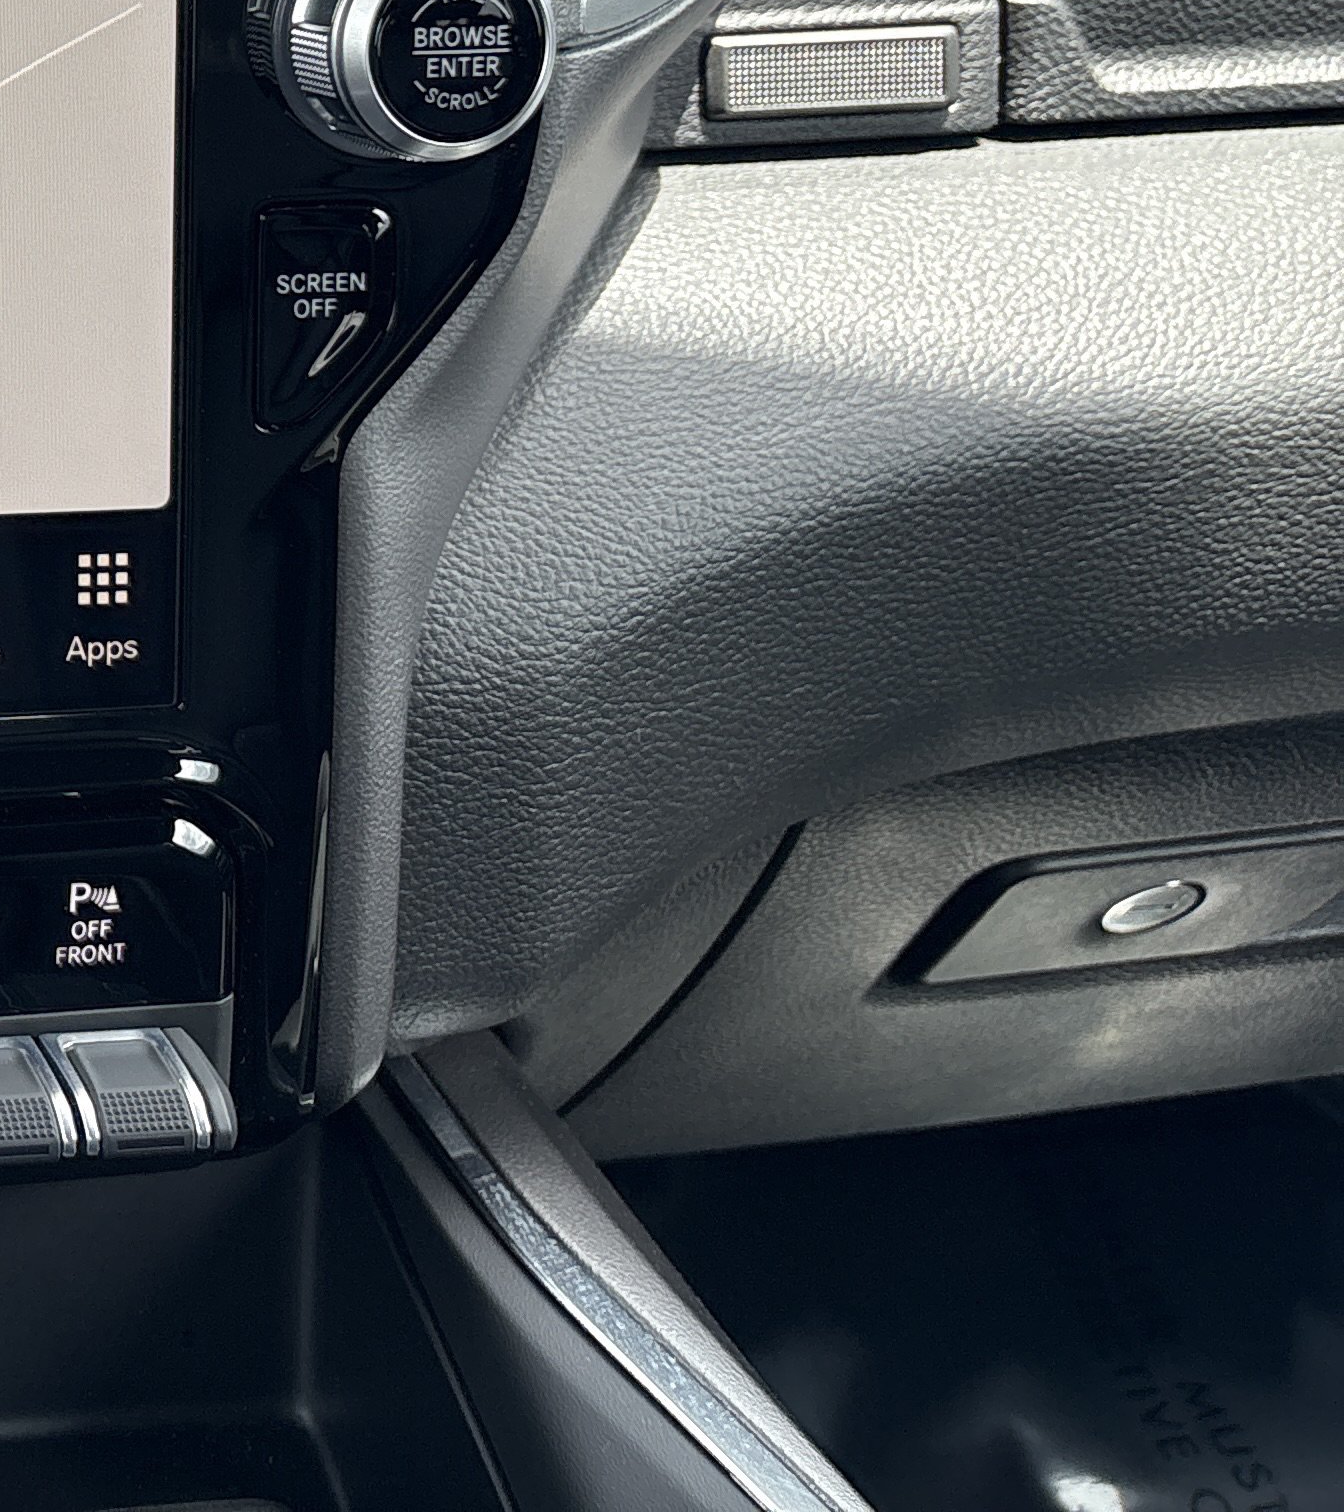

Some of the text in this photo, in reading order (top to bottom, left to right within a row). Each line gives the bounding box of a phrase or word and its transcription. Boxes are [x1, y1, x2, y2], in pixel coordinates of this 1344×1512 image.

[414, 24, 511, 49] BROWSE
[425, 56, 501, 80] ENTER
[424, 85, 501, 111] SCROLL
[276, 272, 367, 295] SCREEN
[293, 299, 338, 320] OFF
[65, 635, 139, 665] Apps
[71, 919, 113, 941] OFF
[55, 942, 127, 967] FRONT
